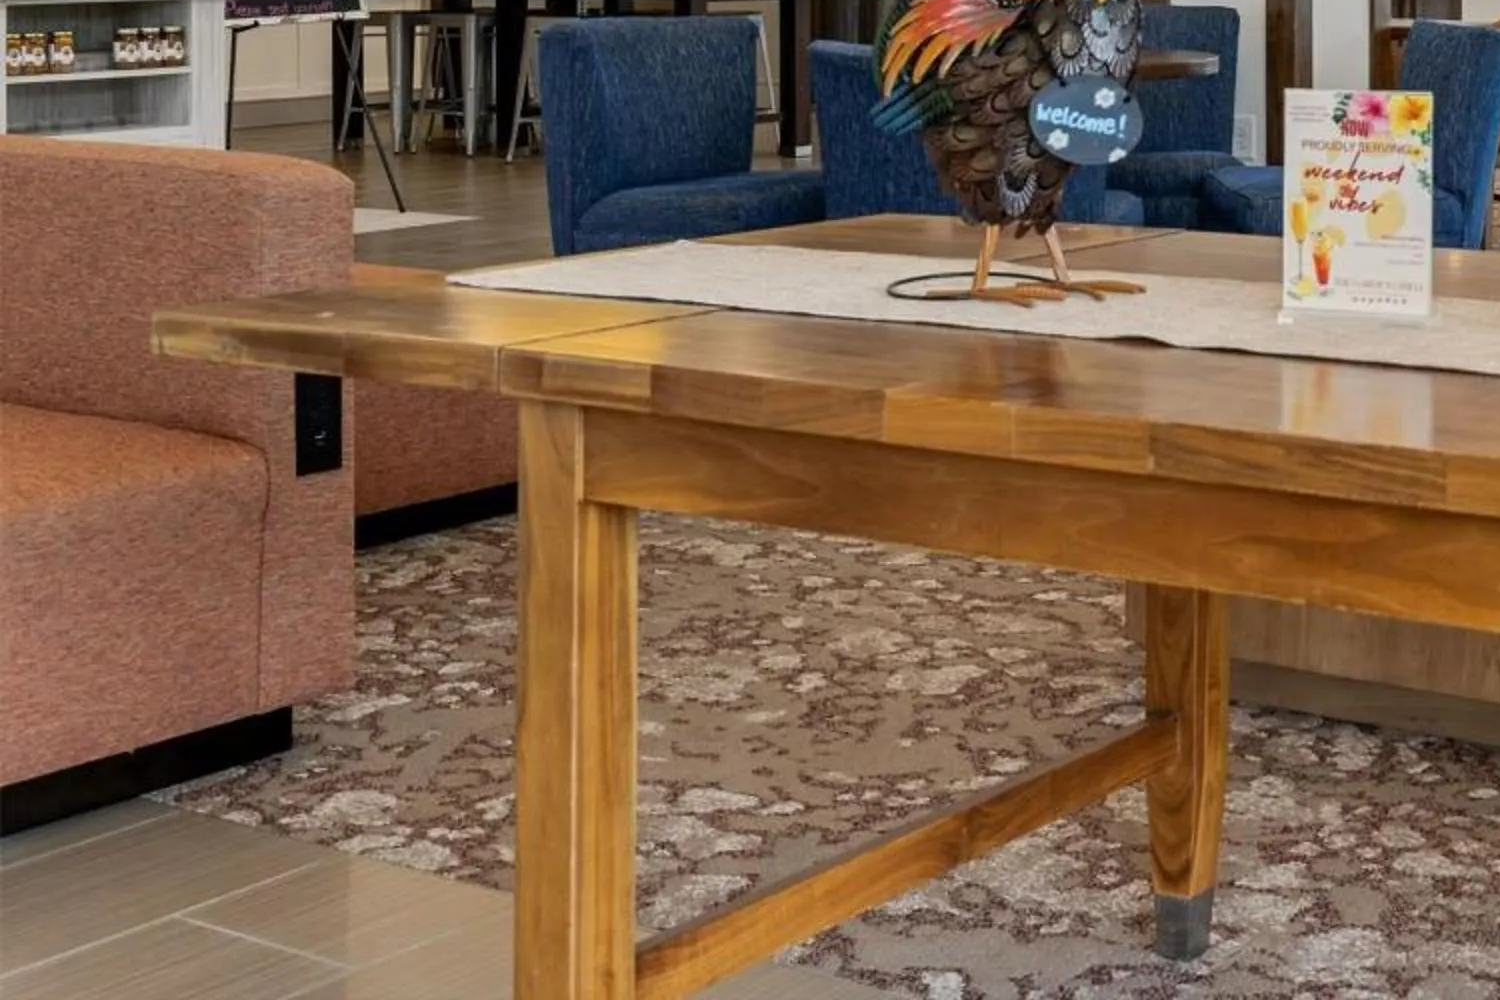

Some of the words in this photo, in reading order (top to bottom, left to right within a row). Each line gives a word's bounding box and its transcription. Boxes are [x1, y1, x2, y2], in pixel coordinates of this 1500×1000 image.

[1340, 119, 1370, 137] NOW
[1301, 138, 1356, 153] PROUDLY
[1304, 151, 1405, 184] weekend
[1329, 185, 1384, 214] vibes
